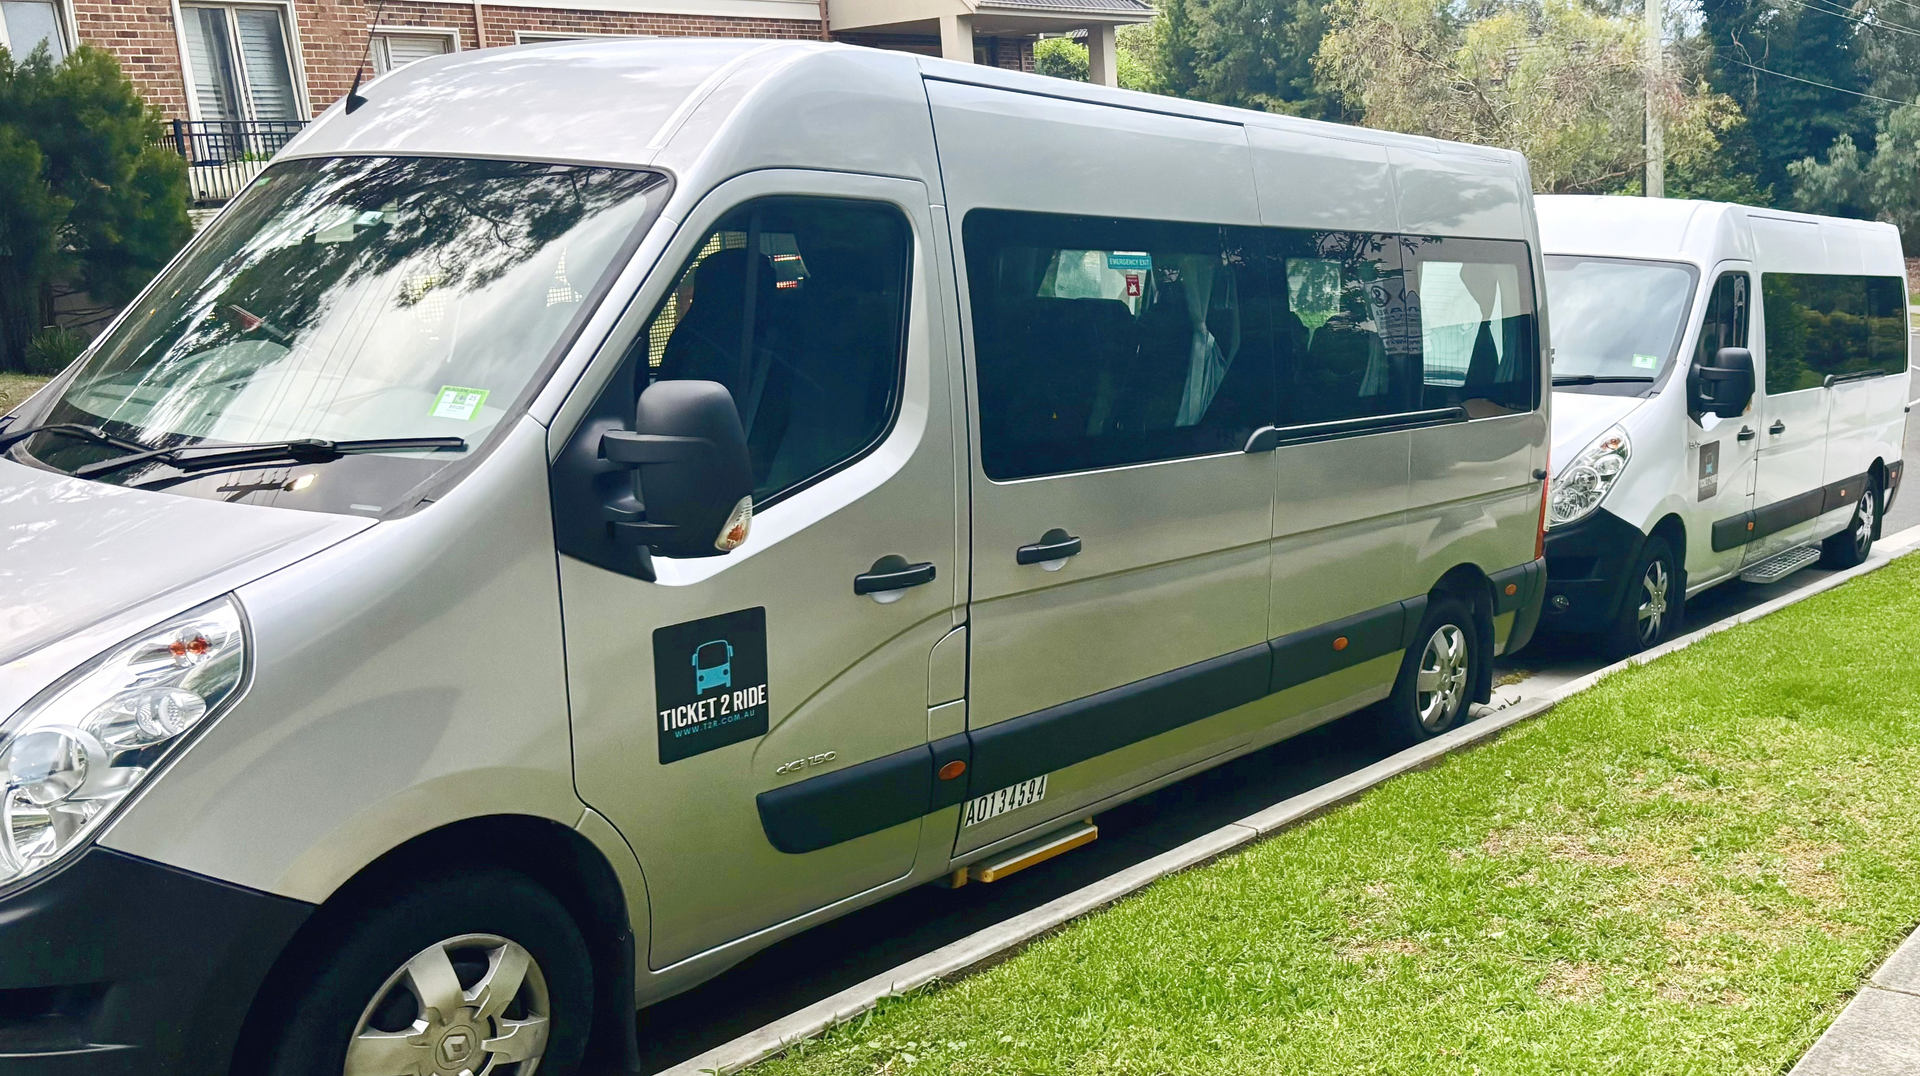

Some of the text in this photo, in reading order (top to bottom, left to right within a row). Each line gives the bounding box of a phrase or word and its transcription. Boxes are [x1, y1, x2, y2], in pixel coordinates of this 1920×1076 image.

[1109, 258, 1150, 266] EMERGENCY EXIT
[660, 684, 767, 731] TICKET 2 RIDE
[674, 709, 755, 738] WWW.T2R.COM.AU
[807, 751, 836, 766] 150
